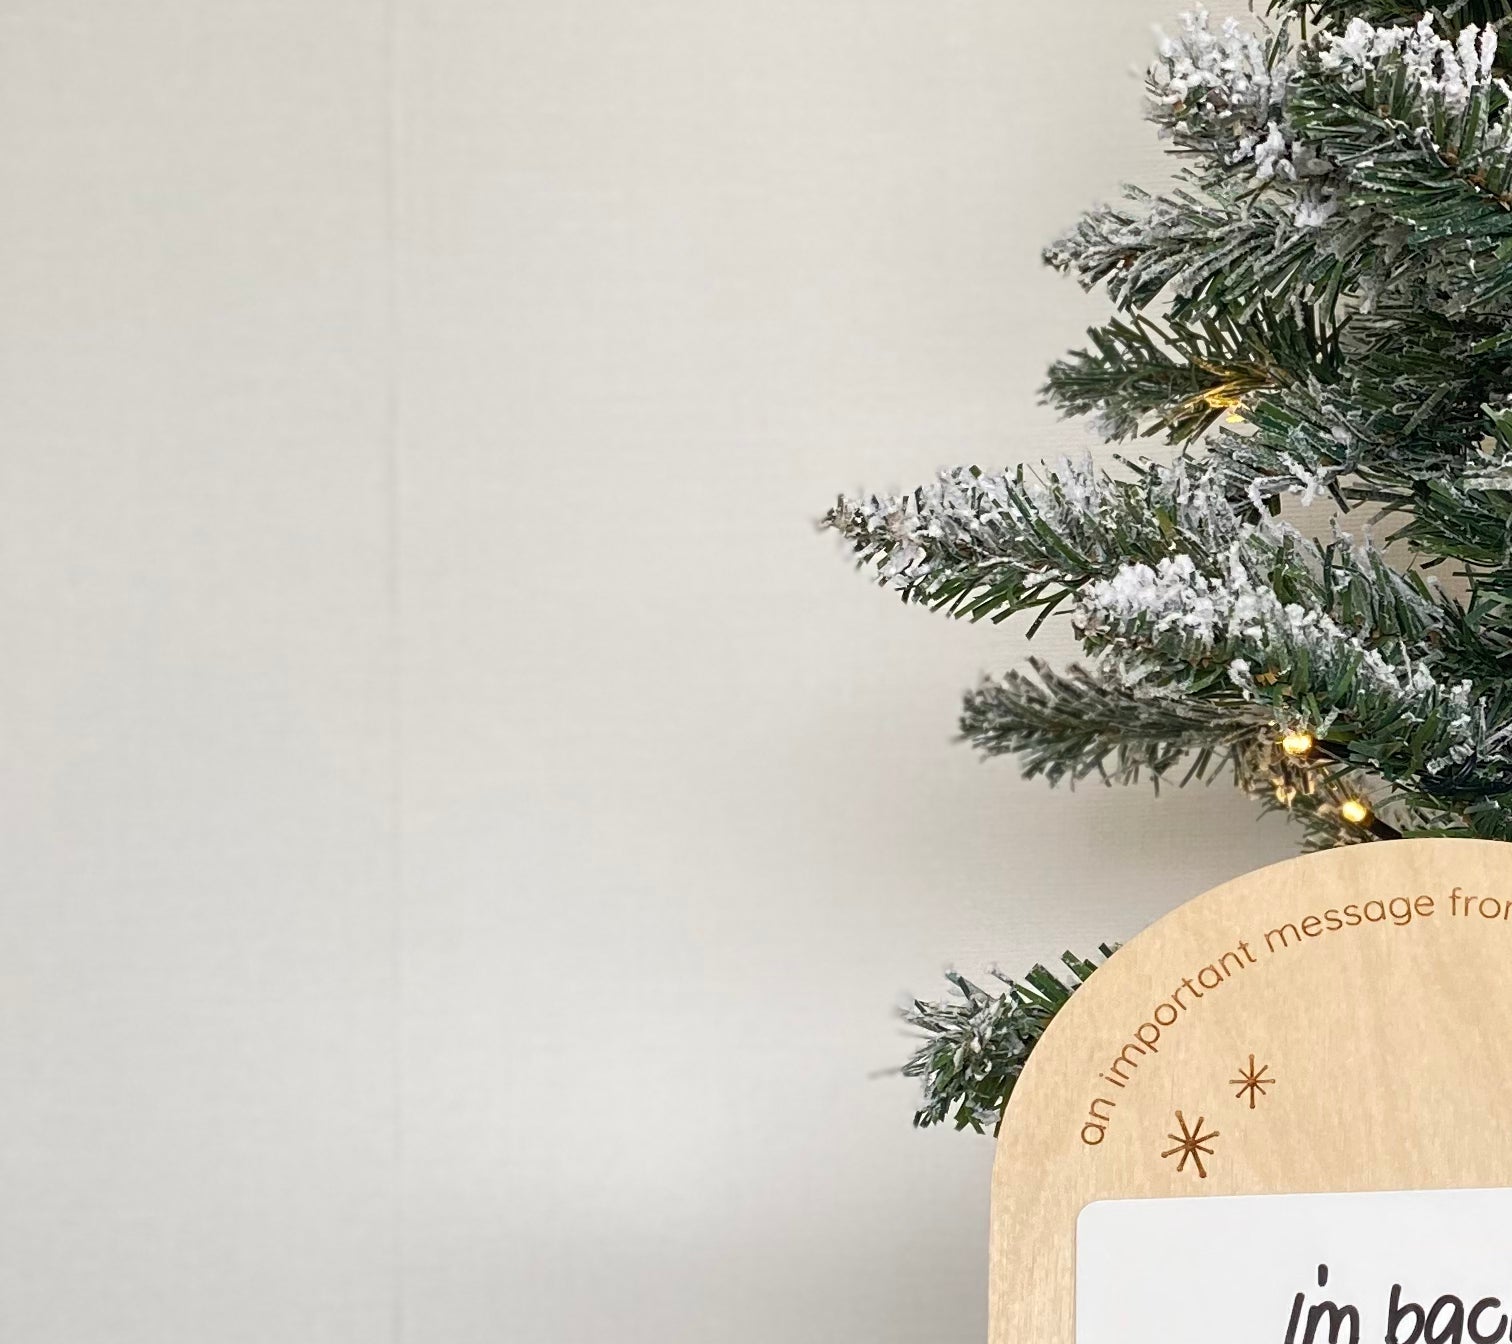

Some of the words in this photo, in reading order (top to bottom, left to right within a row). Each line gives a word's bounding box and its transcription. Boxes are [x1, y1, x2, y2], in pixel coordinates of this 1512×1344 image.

[1081, 1098, 1116, 1145] an
[1099, 940, 1257, 1088] important
[1264, 895, 1435, 953] message
